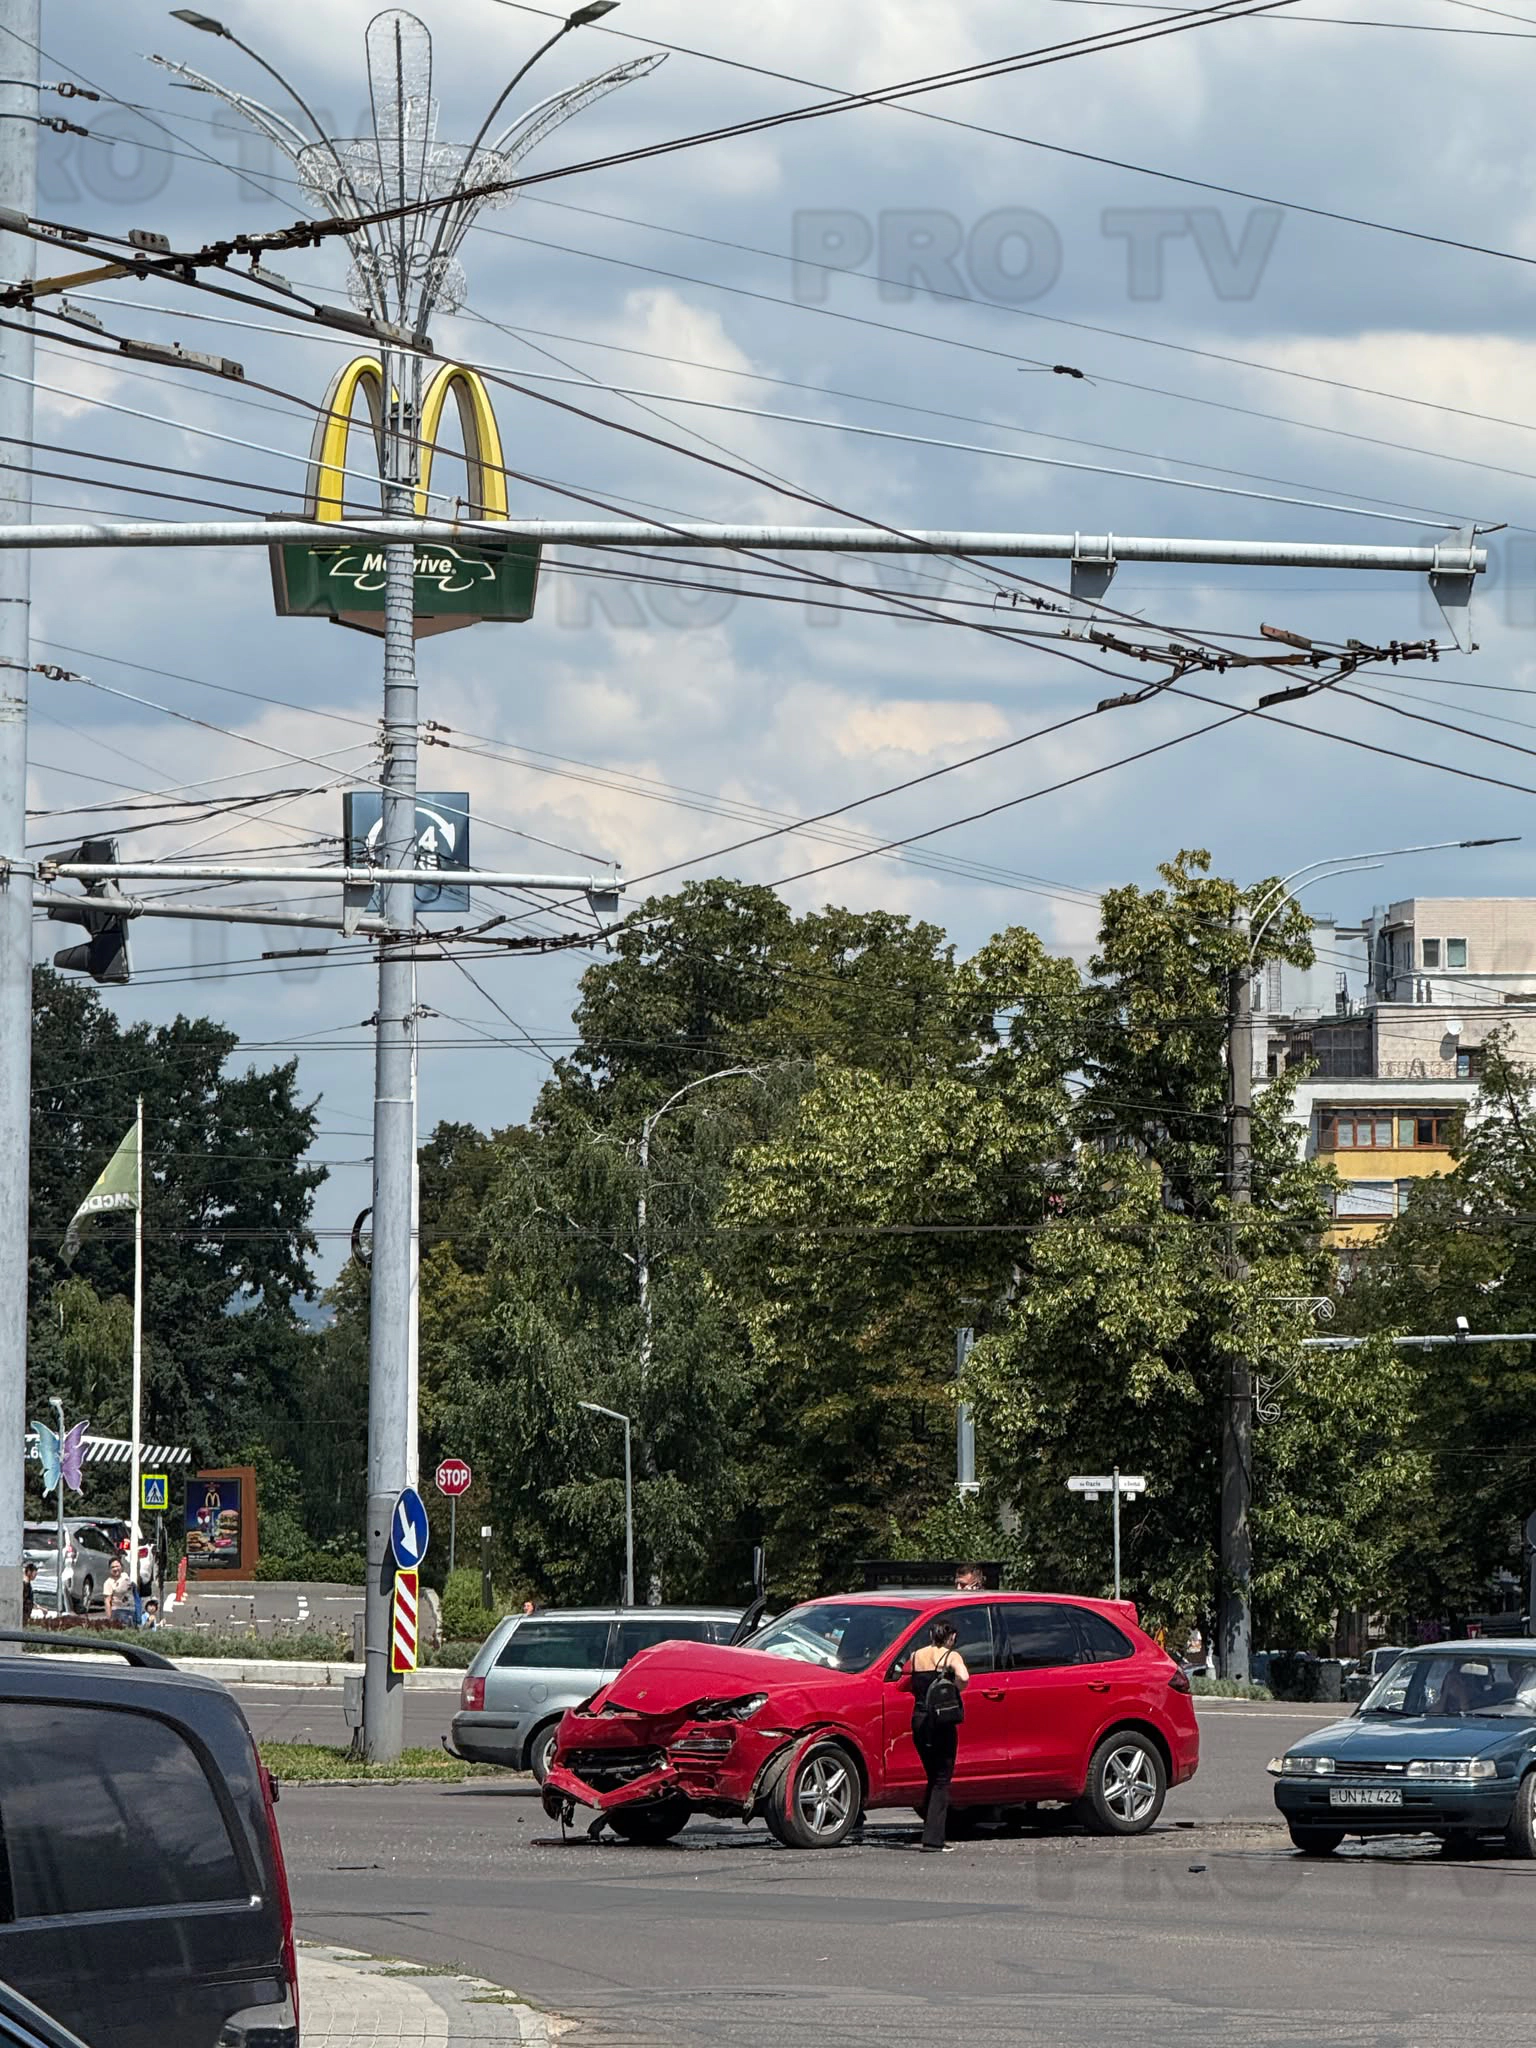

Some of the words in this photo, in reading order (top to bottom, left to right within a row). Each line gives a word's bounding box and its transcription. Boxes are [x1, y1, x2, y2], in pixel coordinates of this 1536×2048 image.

[439, 1469, 468, 1486] STOP
[1339, 1790, 1357, 1803] UN
[1376, 1790, 1399, 1803] 422
